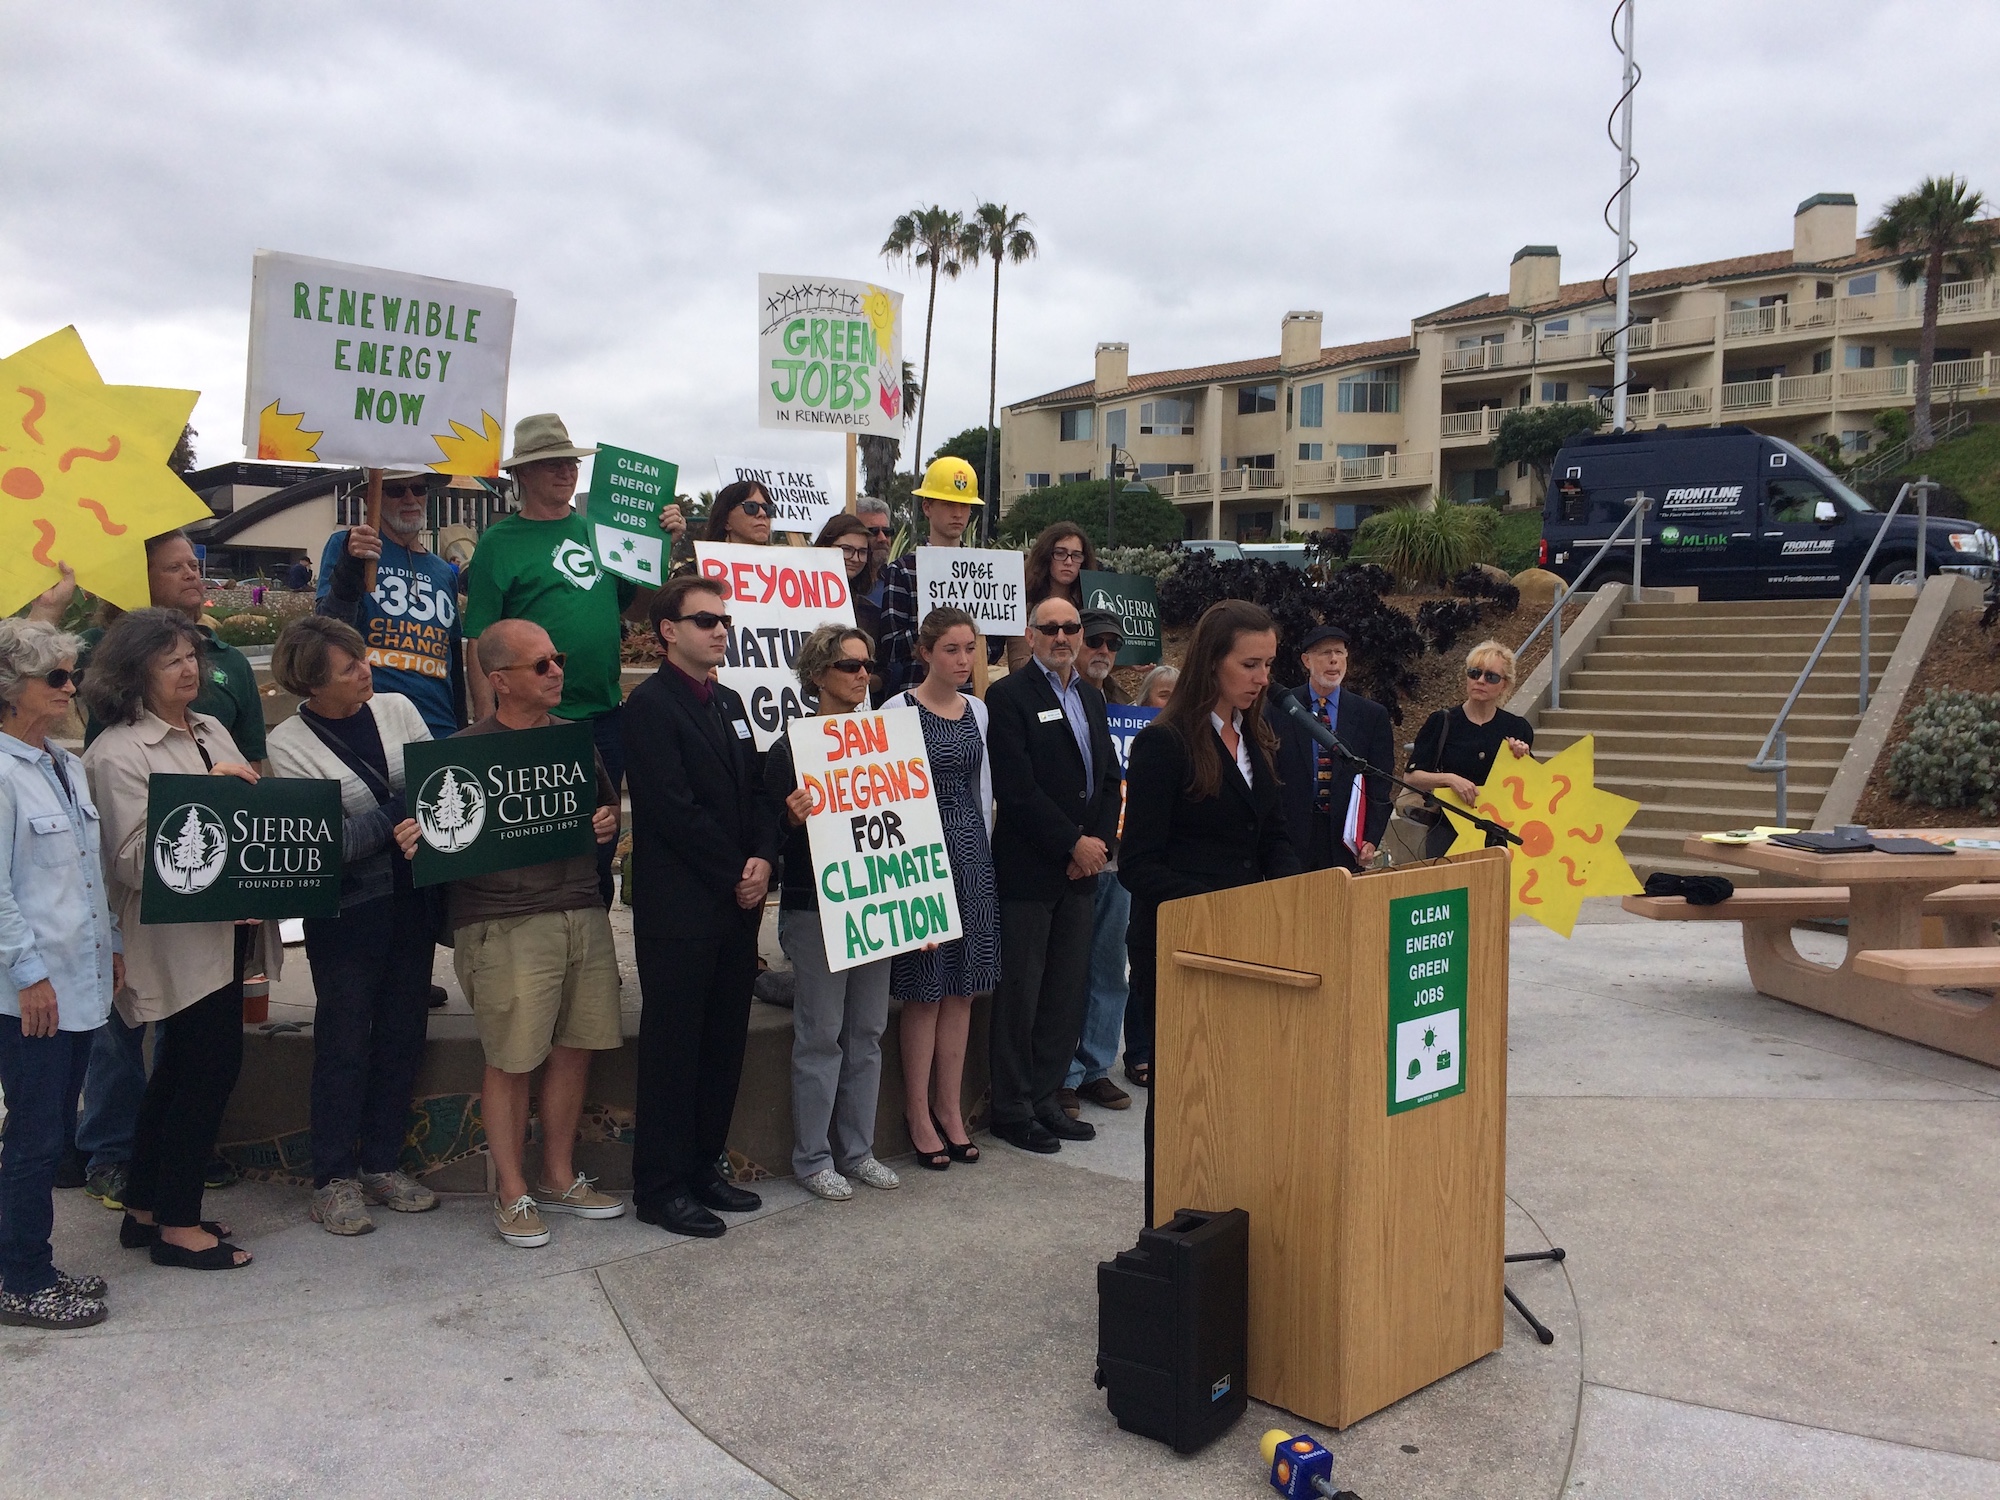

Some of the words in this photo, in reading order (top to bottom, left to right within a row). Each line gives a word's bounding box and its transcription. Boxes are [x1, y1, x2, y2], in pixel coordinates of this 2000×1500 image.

[293, 281, 481, 343] RENEWABLE
[783, 317, 877, 367] GREEN
[334, 339, 451, 382] ENERGY
[771, 359, 871, 411] JOBS
[354, 387, 425, 426] NOW
[776, 410, 789, 421] IN
[795, 409, 870, 427] RENEWABLES
[617, 457, 659, 478] CLEAN
[735, 467, 772, 485] DONT
[777, 472, 815, 488] TAKE
[610, 473, 662, 496] ENERGY
[1665, 486, 1743, 501] FRONTLINE
[611, 492, 655, 512] GREEN
[768, 487, 830, 506] UNSHINE
[613, 511, 647, 528] JOBS
[1682, 533, 1728, 546] MLink
[1782, 539, 1836, 550] FRONTLINE
[377, 566, 394, 575] AN
[562, 548, 597, 578] G
[951, 560, 994, 579] SDG&E
[702, 558, 847, 608] BEYOND
[929, 580, 968, 599] STAY
[973, 582, 998, 600] OUT
[1003, 583, 1017, 601] OF
[963, 602, 1017, 621] WALLET
[1116, 594, 1157, 618] SIERRA
[1123, 616, 1155, 637] CLUB
[718, 626, 813, 669] NATU
[367, 649, 447, 677] ACTION
[1107, 716, 1121, 728] AN
[1124, 718, 1152, 730] DIEG
[823, 714, 889, 762] SAN
[487, 760, 588, 797] SIERRA
[802, 757, 930, 817] DIEGANS
[498, 789, 578, 824] CLUB
[231, 809, 334, 843] SIERRA
[500, 824, 553, 840] FOUNDED
[557, 819, 579, 831] 1892
[850, 810, 906, 853] FOR
[239, 843, 322, 873] CLUB
[238, 880, 294, 889] FOUNDED
[298, 879, 321, 888] 1892
[821, 842, 949, 903] CLIMATE
[845, 892, 949, 959] ACTION
[1411, 904, 1450, 926] CLEAN
[1406, 931, 1454, 954] ENERGY
[1409, 958, 1449, 980] GREEN
[1413, 986, 1444, 1007] JOBS
[1299, 1449, 1326, 1461] Televisa
[1288, 1464, 1298, 1496] Televisa
